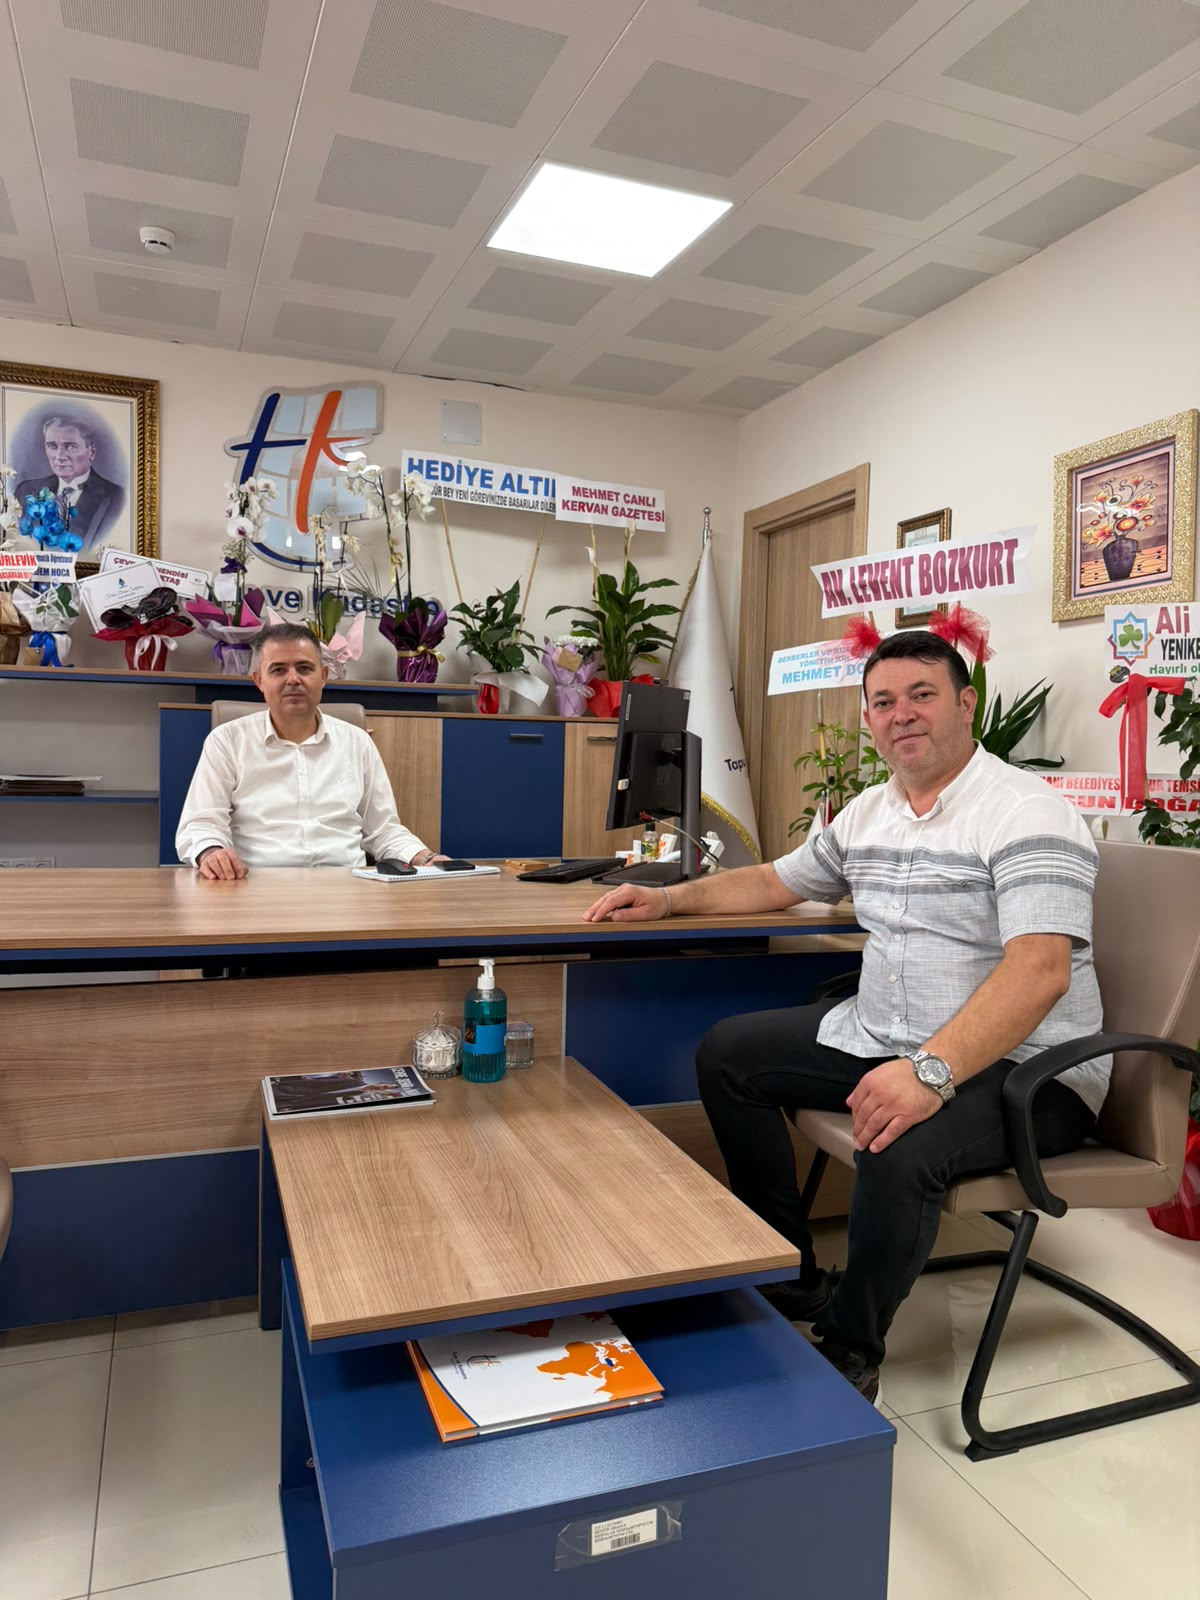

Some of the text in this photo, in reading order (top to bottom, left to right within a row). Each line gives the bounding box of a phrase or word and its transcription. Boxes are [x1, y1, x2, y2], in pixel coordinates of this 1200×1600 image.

[407, 457, 494, 489] HEDİYE
[443, 486, 454, 498] BEY
[572, 485, 656, 508] MEHMET CANLI
[561, 499, 665, 523] KERVAN GAZETESİ
[821, 538, 1019, 609] AV. LEVENT BOZKURT
[266, 588, 300, 608] ve
[1155, 605, 1190, 634] Ali
[782, 665, 842, 684] MEHMET
